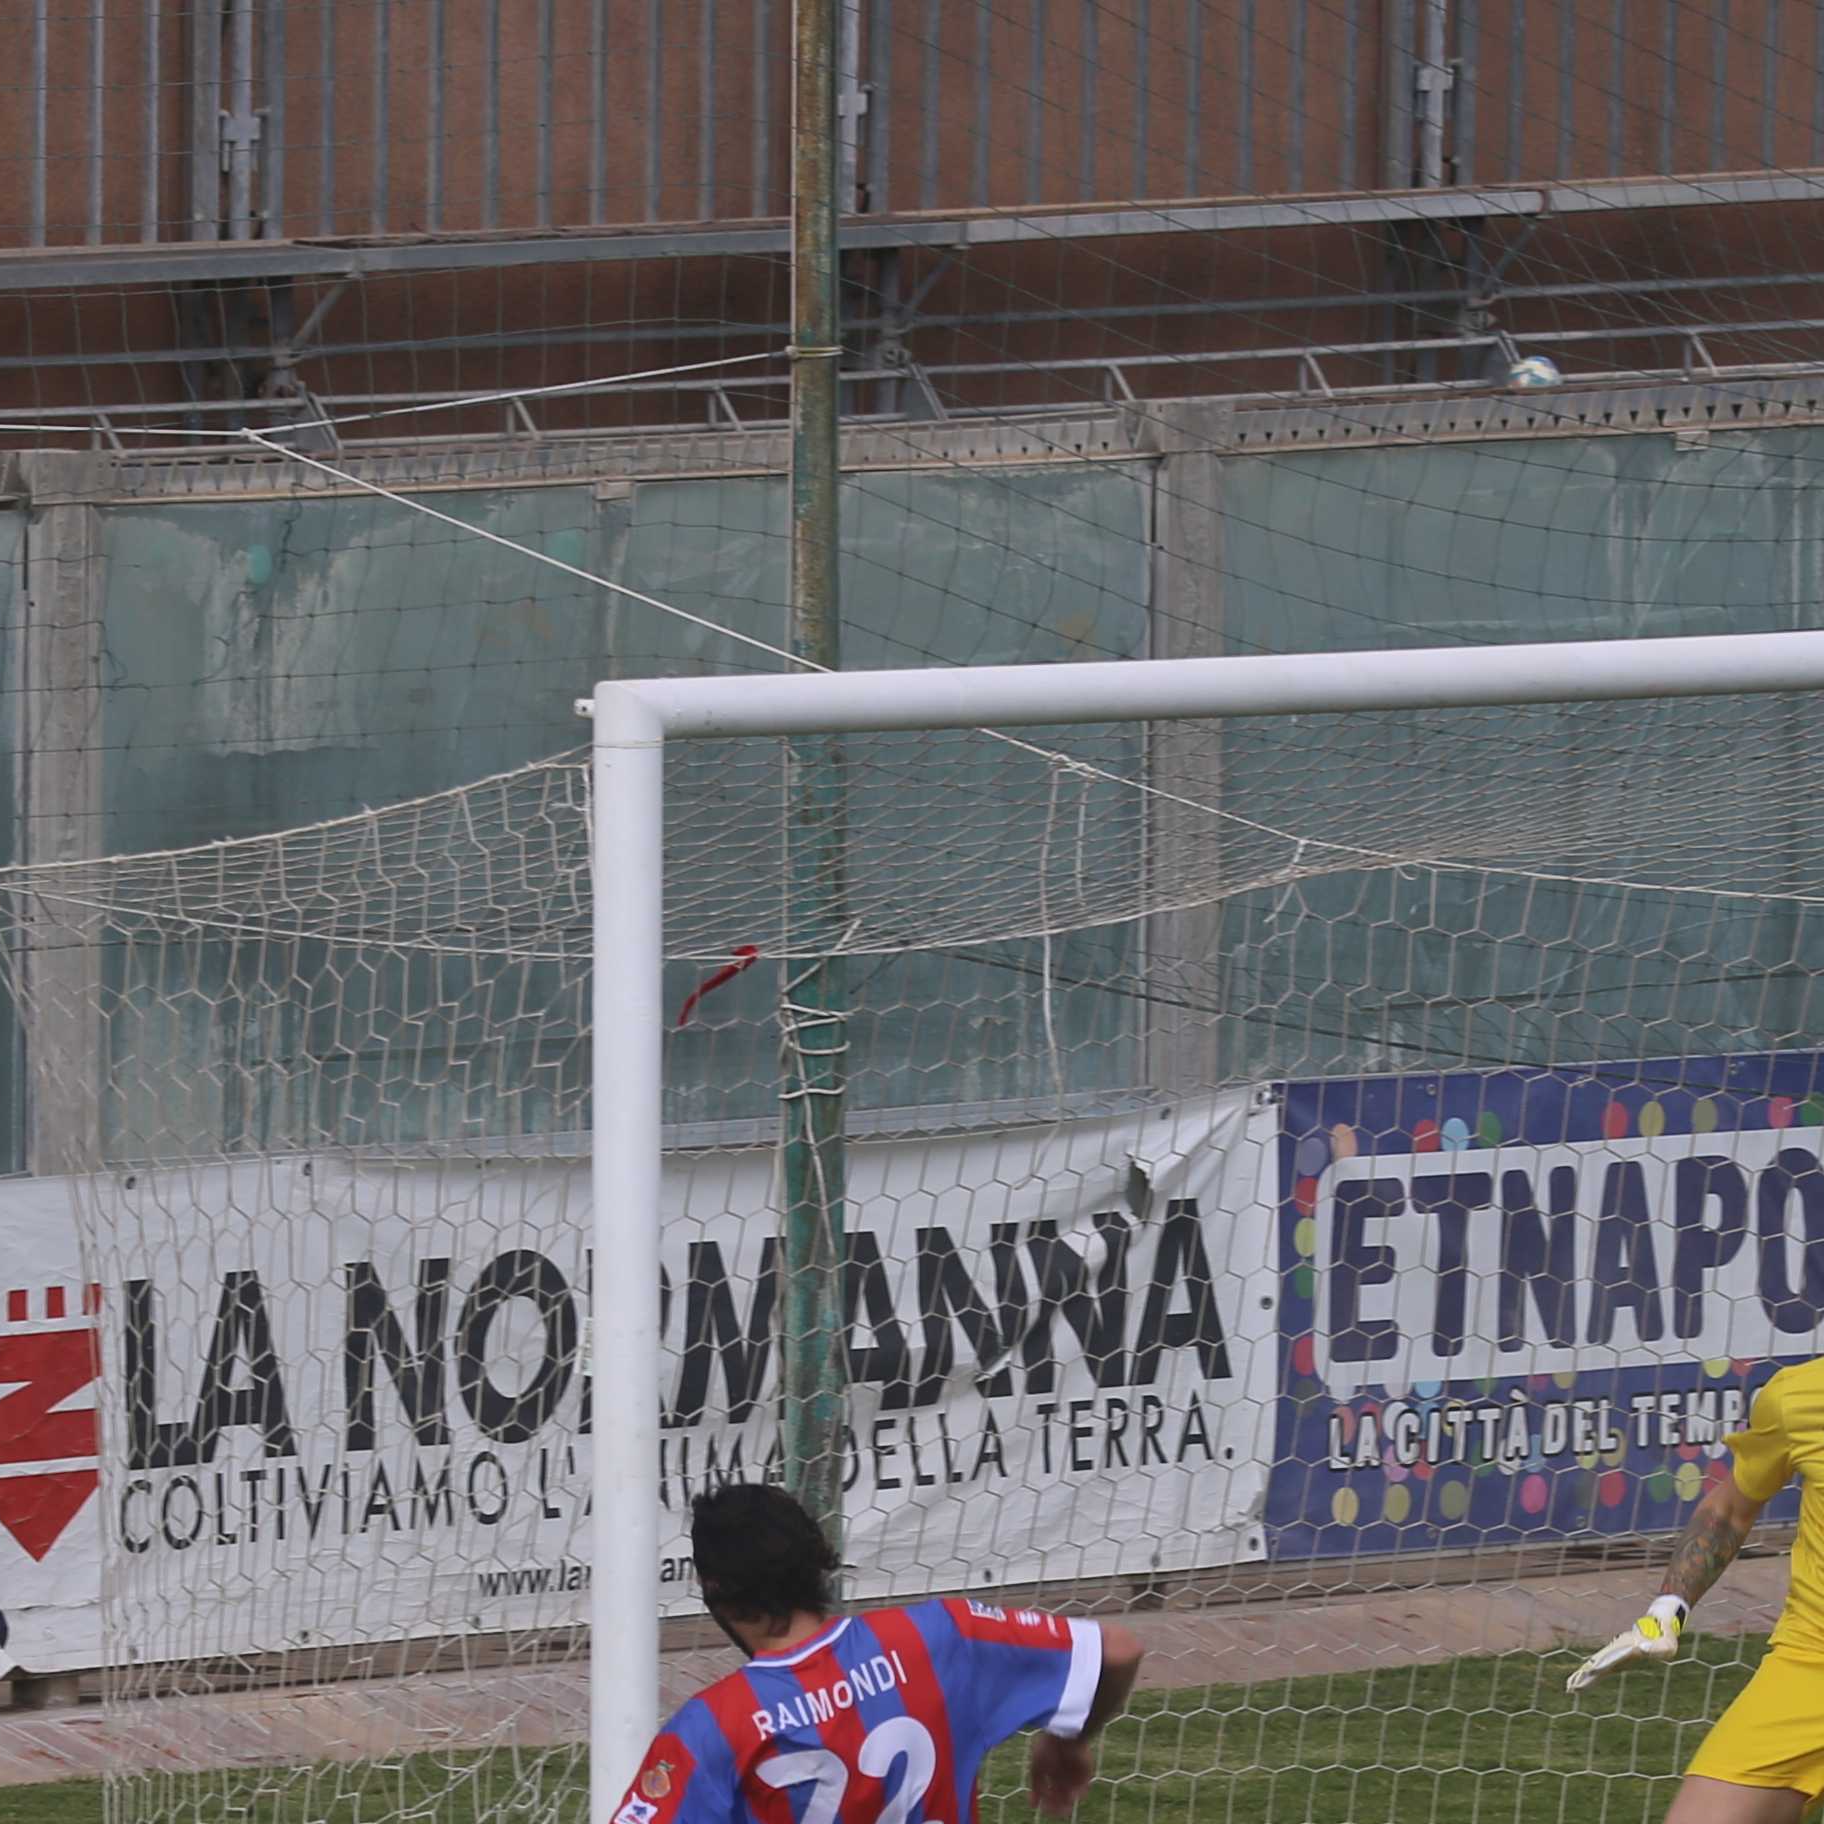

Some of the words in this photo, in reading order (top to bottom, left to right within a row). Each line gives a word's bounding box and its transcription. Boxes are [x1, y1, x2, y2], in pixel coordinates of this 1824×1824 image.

[124, 1269, 297, 1471] LA
[342, 1198, 1233, 1453] NOMANNA
[120, 1450, 510, 1554] COLTIVIAMO
[1036, 1389, 1234, 1474] TERRA.
[1328, 1412, 1381, 1470] LA
[1393, 1387, 1530, 1467] CITTÀ
[1542, 1399, 1620, 1456] DEL
[1631, 1387, 1764, 1448] TEMP
[751, 1649, 908, 1741] RAIMONDI
